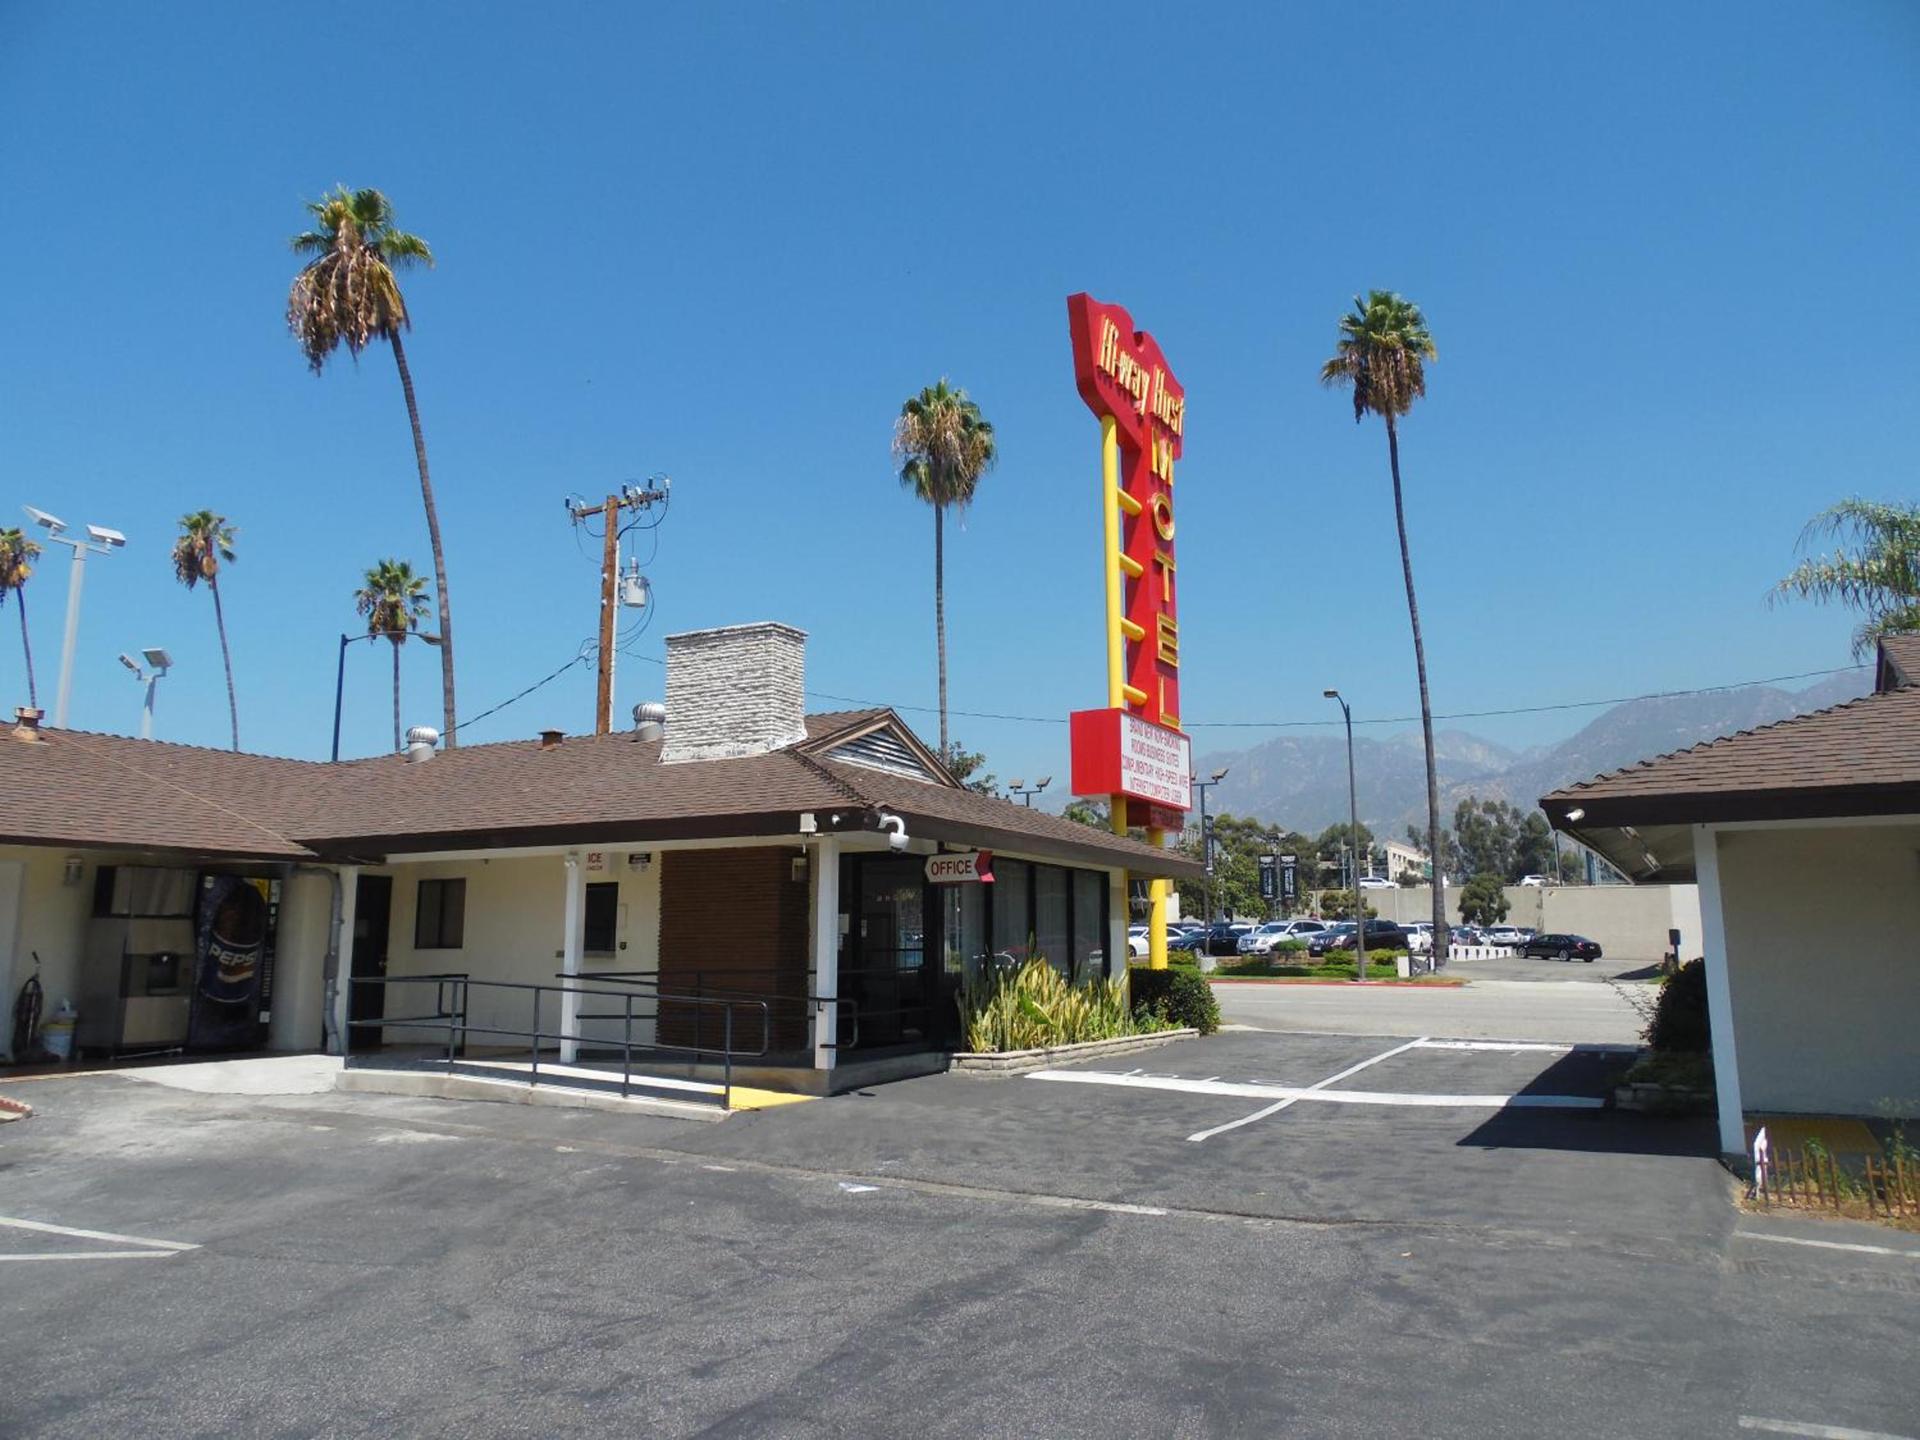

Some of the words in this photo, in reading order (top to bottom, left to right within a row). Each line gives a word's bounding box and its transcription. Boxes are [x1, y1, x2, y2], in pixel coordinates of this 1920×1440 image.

[1151, 426, 1181, 731] MOTEL
[588, 852, 602, 863] ICE
[931, 860, 972, 876] OFFICE
